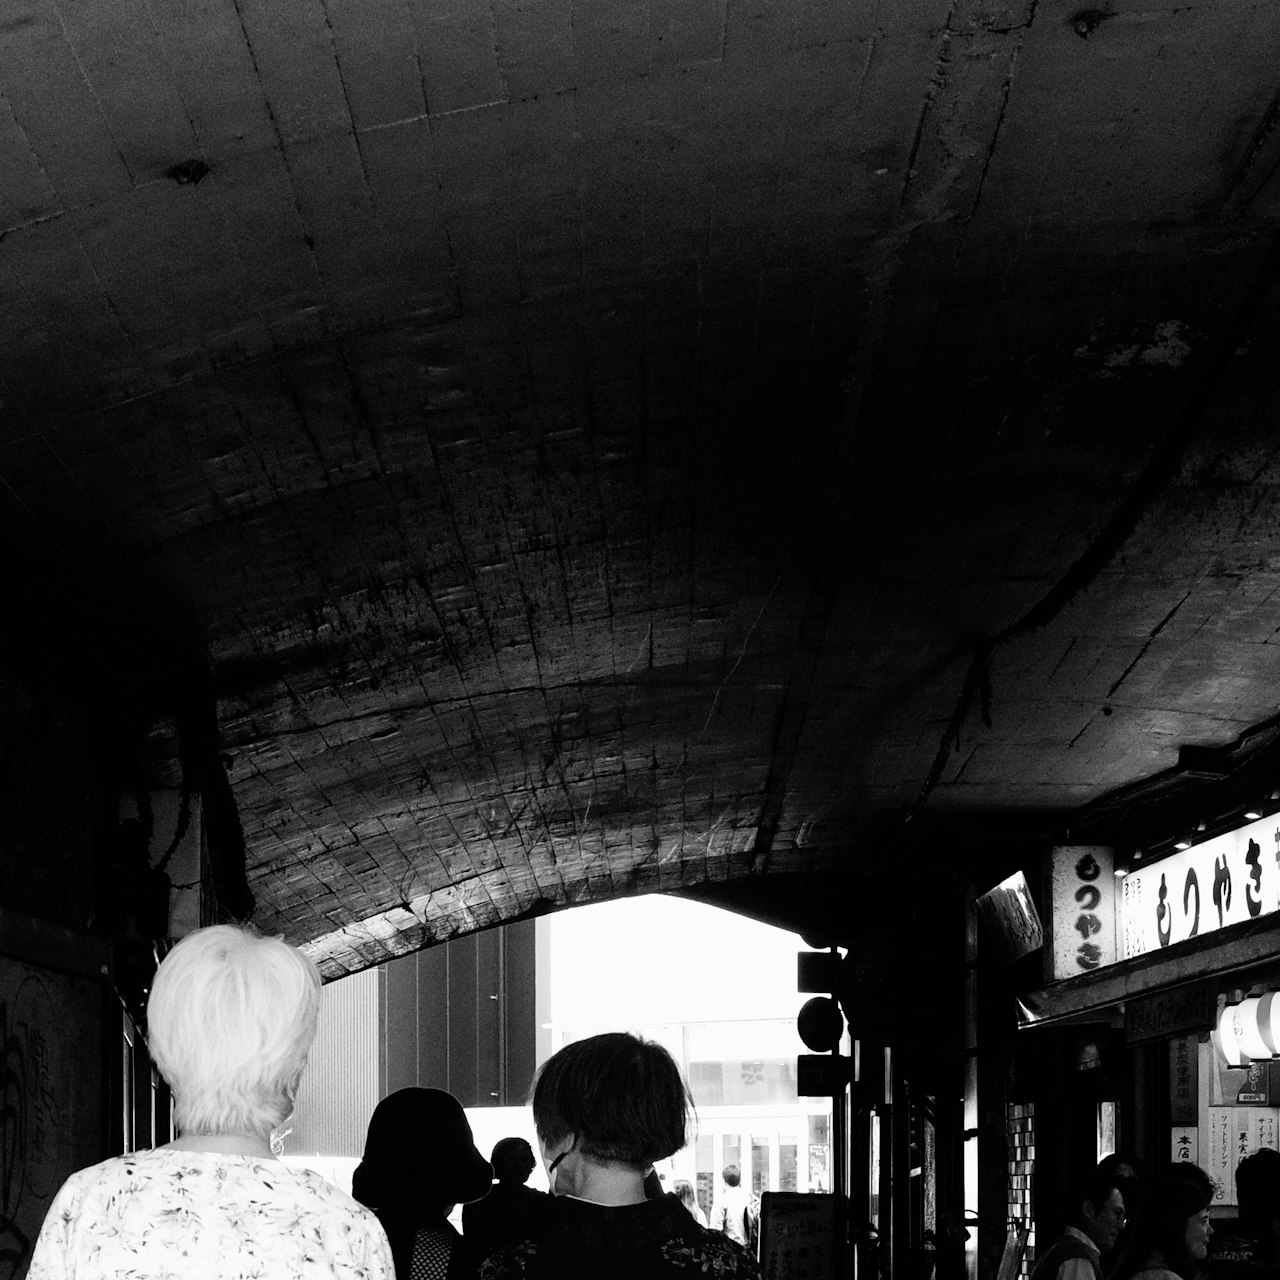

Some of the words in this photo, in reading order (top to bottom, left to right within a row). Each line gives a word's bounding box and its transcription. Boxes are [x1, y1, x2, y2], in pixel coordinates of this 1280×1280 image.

[1074, 853, 1102, 971] もつやき
[1156, 837, 1263, 947] もつやき
